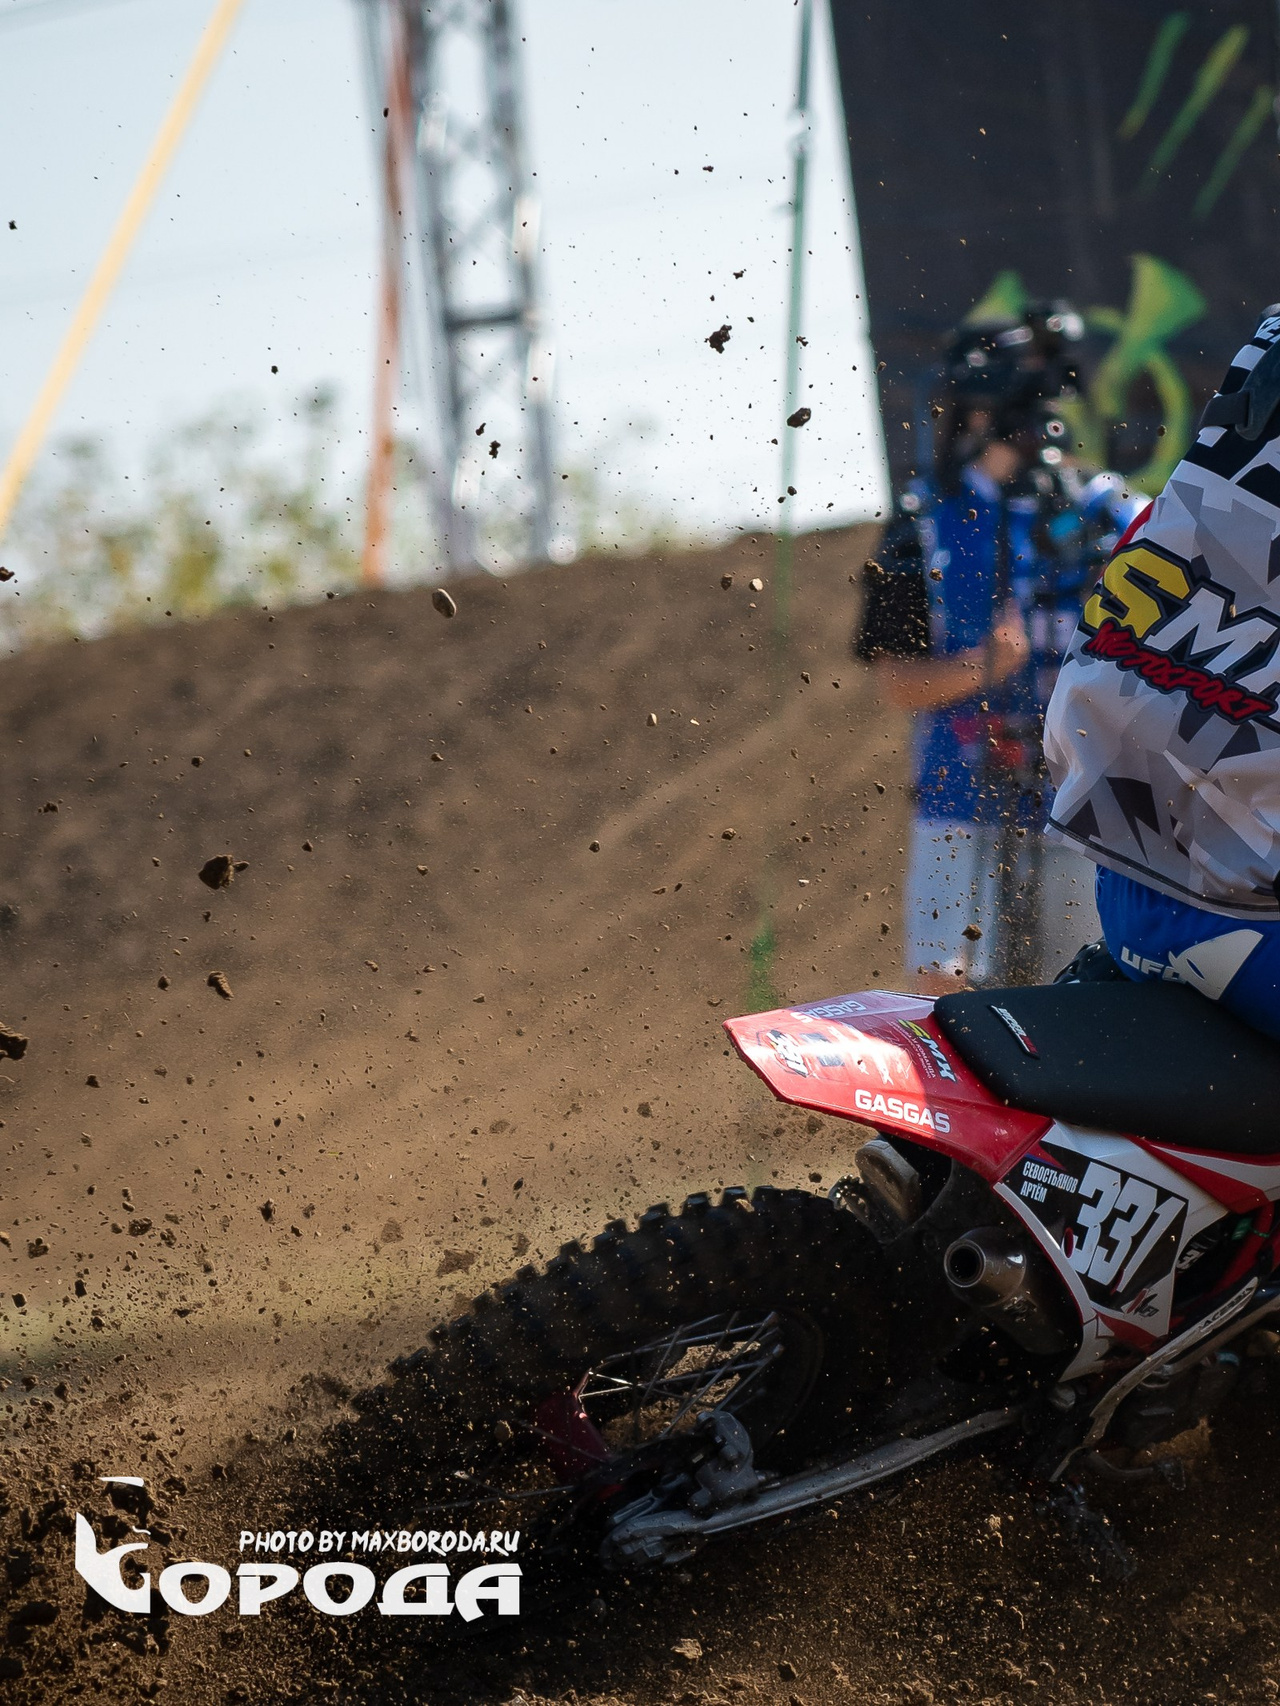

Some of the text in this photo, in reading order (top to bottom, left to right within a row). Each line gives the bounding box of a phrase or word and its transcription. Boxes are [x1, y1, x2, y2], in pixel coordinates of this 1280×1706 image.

[1088, 621, 1274, 719] MOTOSPORT
[1121, 946, 1187, 985] UFO
[855, 1089, 950, 1134] GASGAS
[1020, 1180, 1048, 1204] АРТЁМ
[1022, 1160, 1079, 1195] СЕВОСТЬЯНОВ
[1064, 1161, 1187, 1294] 331
